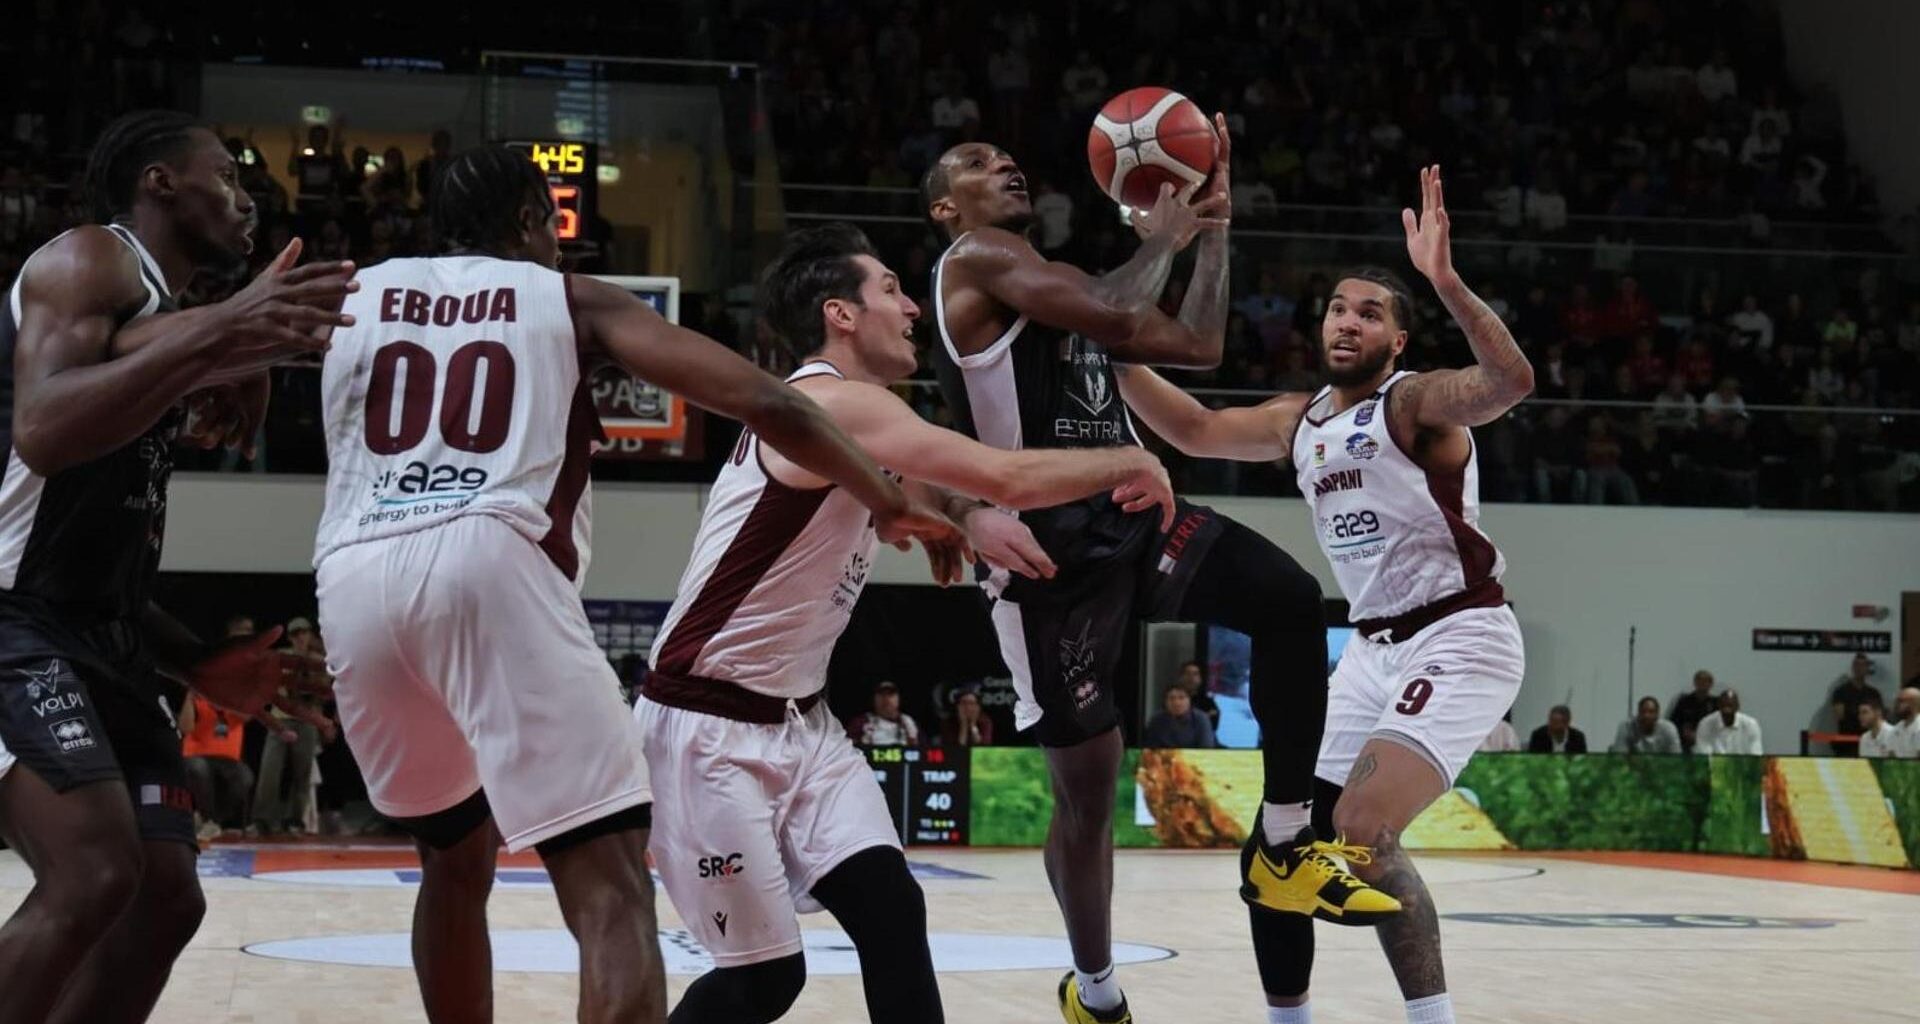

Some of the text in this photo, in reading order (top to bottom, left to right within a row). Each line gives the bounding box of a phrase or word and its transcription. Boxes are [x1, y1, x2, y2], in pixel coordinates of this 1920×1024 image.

[380, 288, 516, 327] EBOUA
[365, 340, 515, 455] 00
[398, 461, 488, 494] a29
[414, 504, 429, 516] to
[1333, 510, 1379, 538] a29
[1396, 678, 1433, 715] 9
[922, 770, 957, 783] TRAP
[925, 792, 952, 811] 40
[699, 853, 743, 877] SRC
